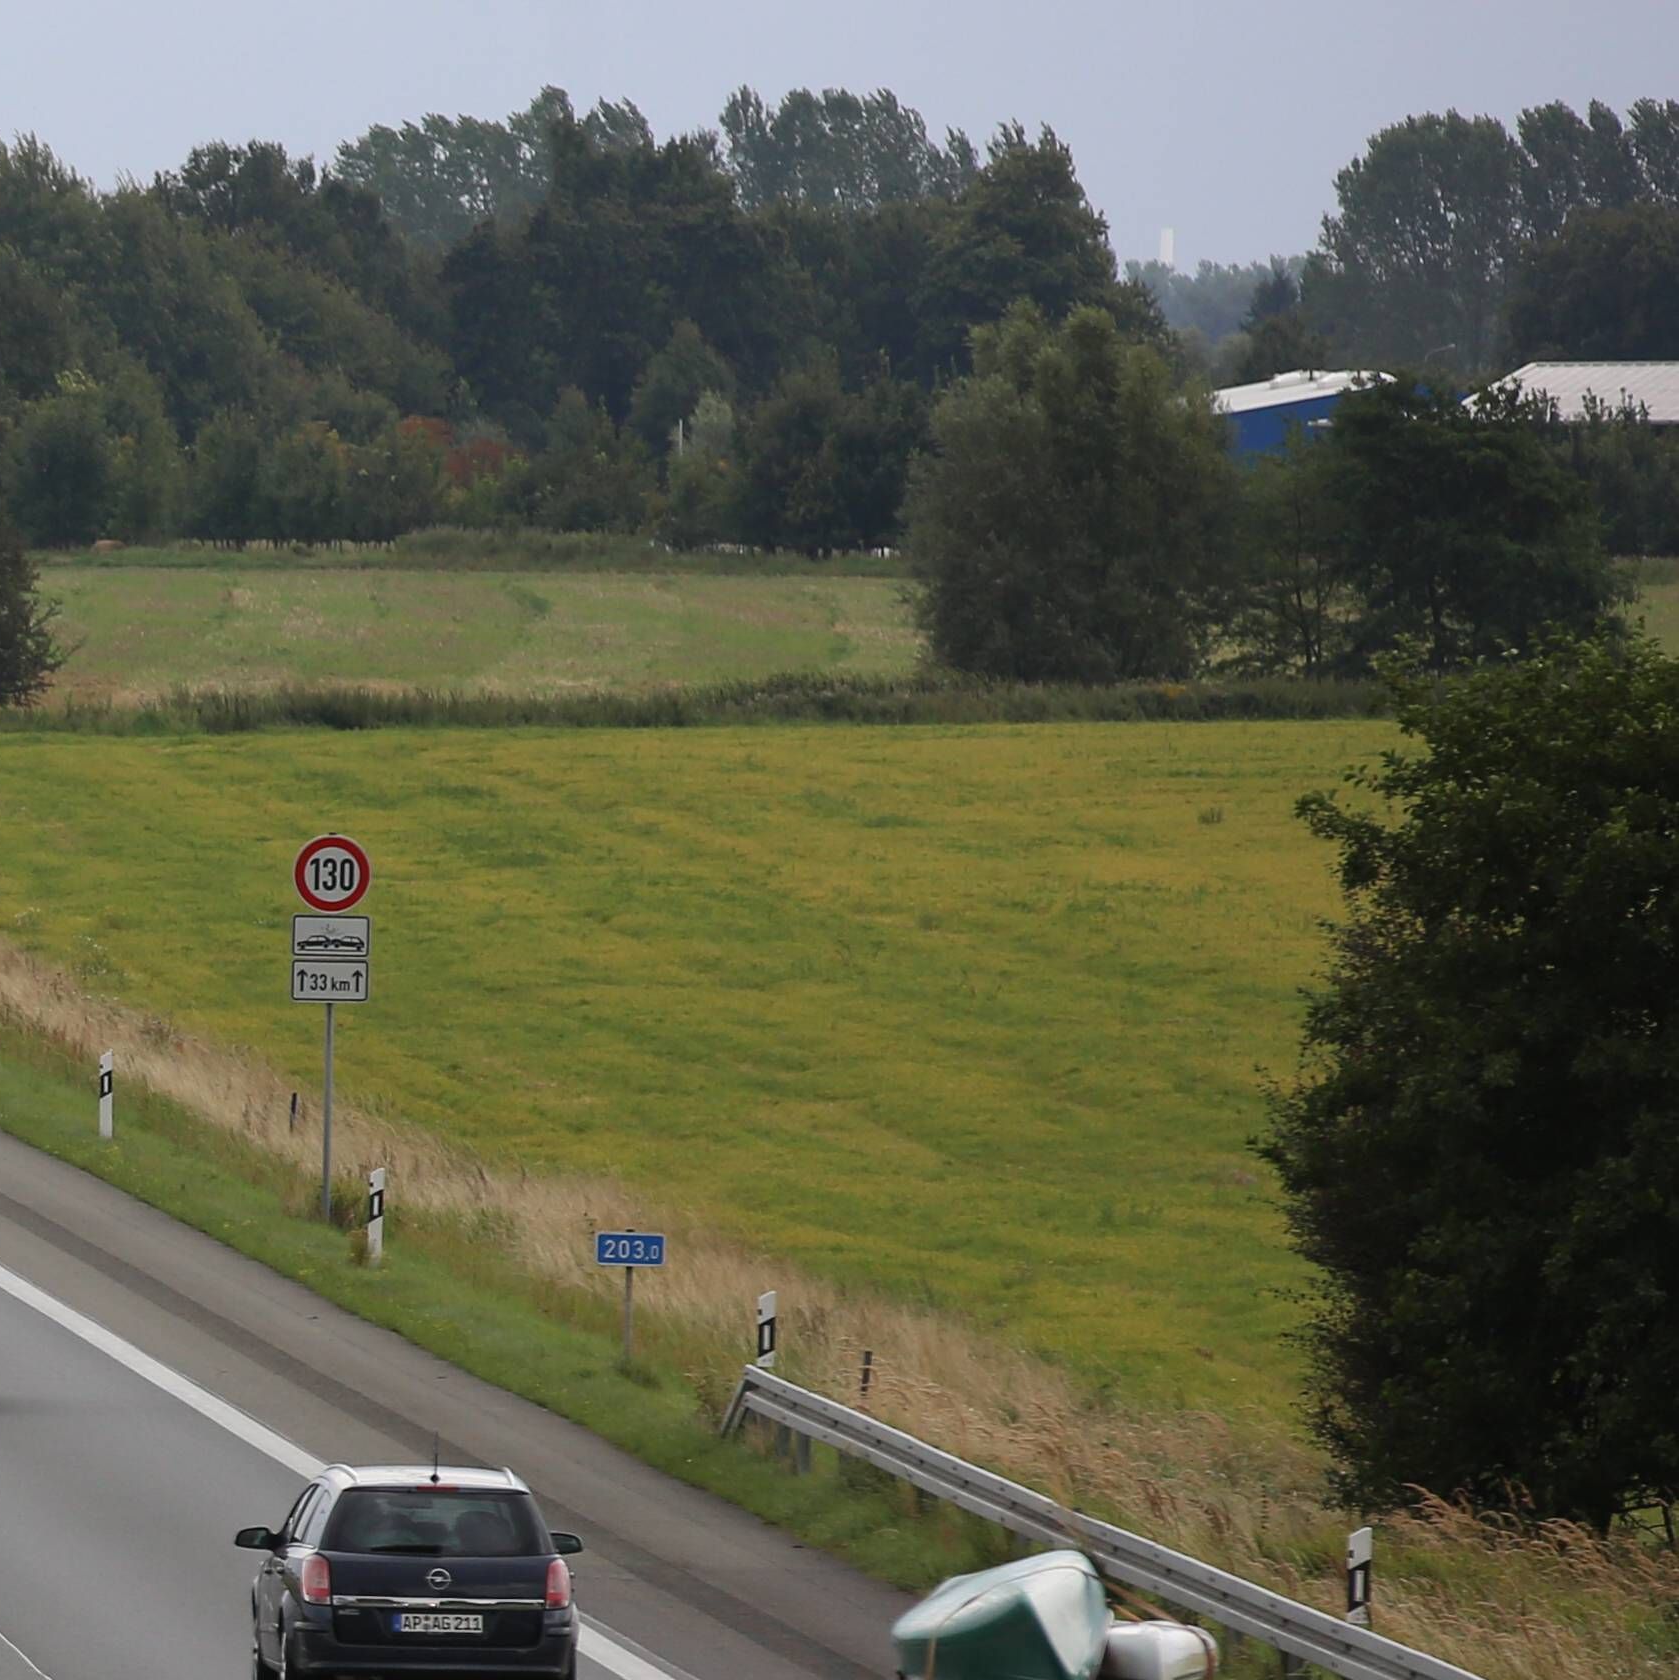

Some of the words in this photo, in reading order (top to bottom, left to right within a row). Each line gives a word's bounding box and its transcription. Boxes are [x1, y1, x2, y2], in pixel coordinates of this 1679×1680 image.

[310, 858, 355, 891] 130
[310, 974, 327, 991] 33
[331, 978, 350, 991] km
[403, 1616, 421, 1630] AP
[432, 1616, 451, 1630] AG
[455, 1616, 482, 1630] 211
